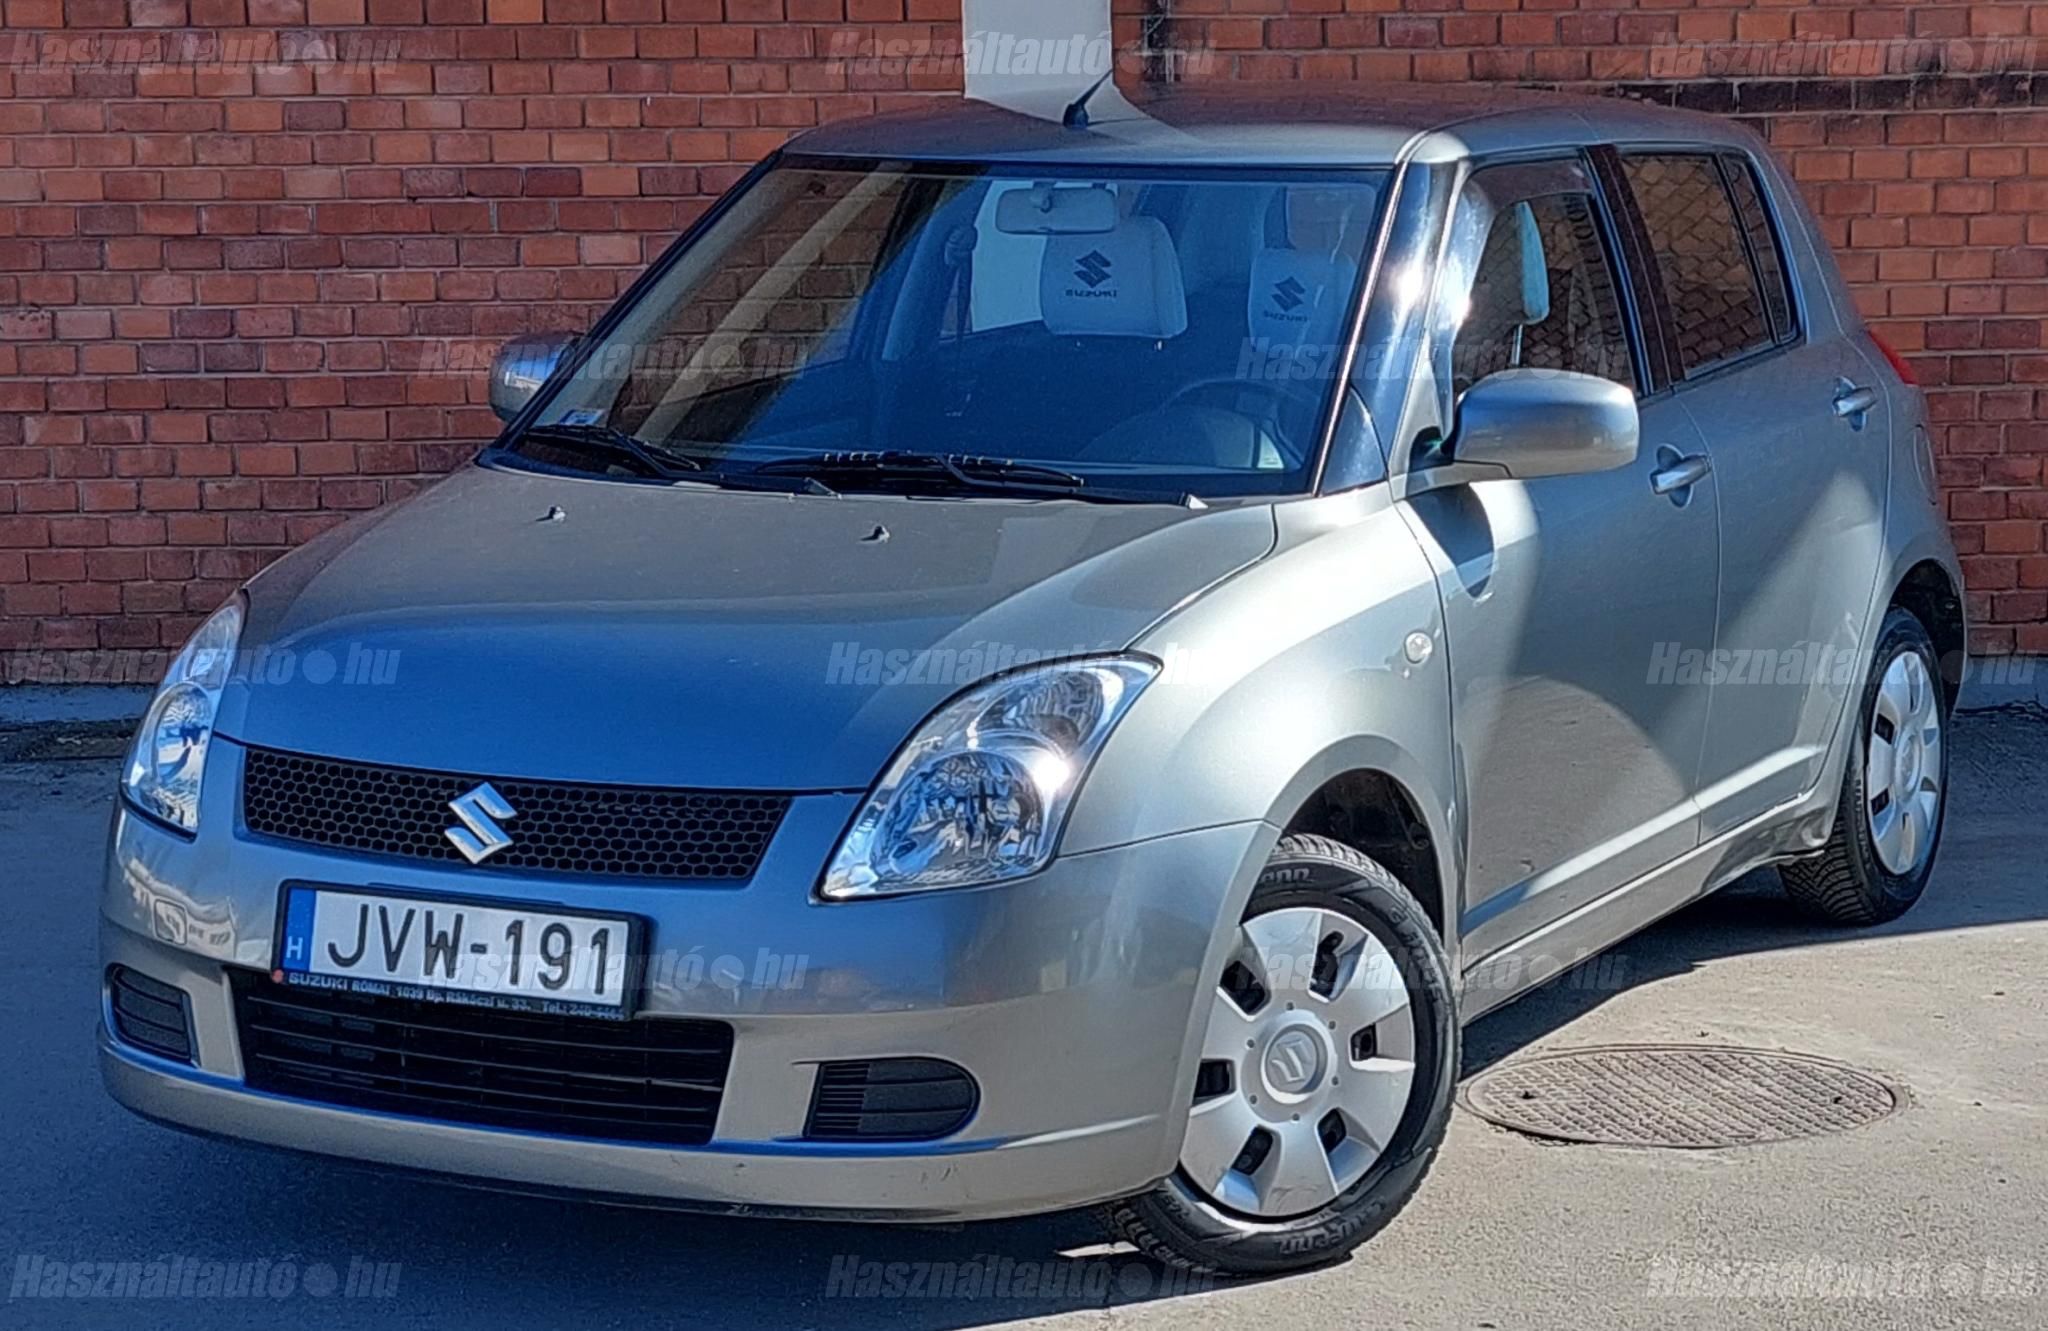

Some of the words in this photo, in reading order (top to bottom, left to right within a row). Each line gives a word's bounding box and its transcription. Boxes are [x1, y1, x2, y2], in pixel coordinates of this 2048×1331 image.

[1065, 288, 1118, 299] SUZUKI
[285, 937, 304, 961] H
[327, 903, 610, 996] JVW-191
[288, 971, 348, 991] SUZUKI
